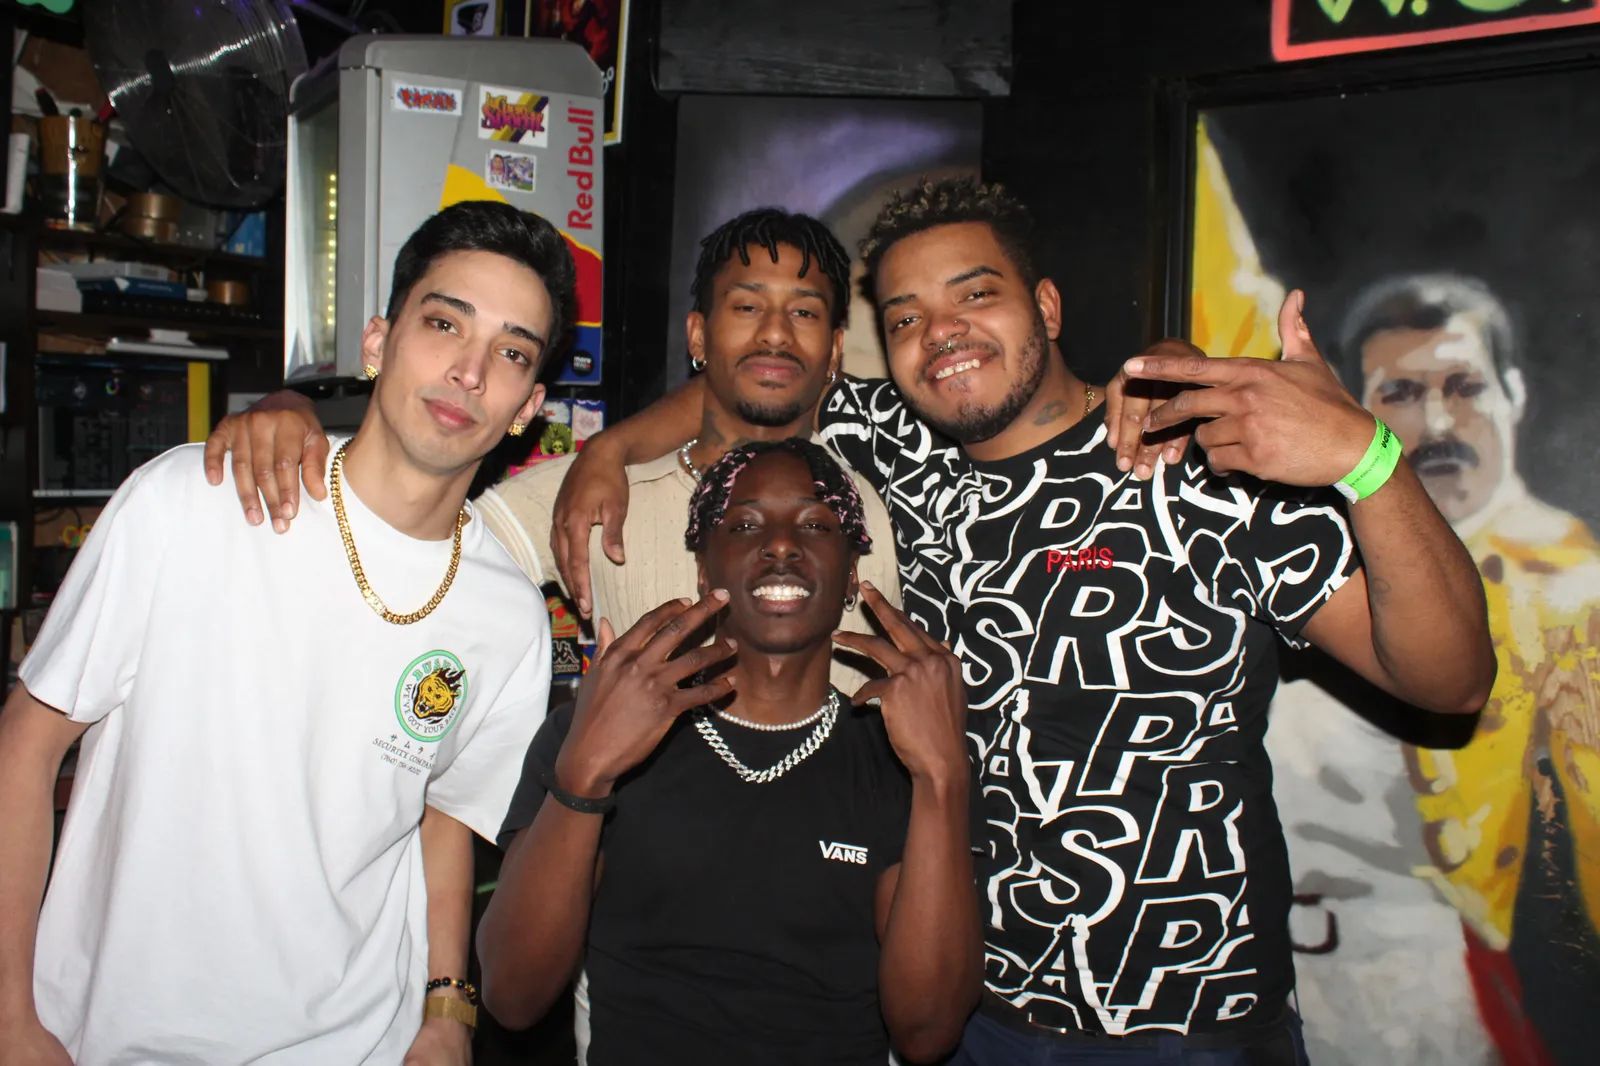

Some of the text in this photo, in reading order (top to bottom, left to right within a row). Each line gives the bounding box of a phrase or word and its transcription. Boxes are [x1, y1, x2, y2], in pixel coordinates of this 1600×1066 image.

[567, 107, 595, 230] Red Bull
[1046, 546, 1114, 574] PARIS
[408, 715, 422, 730] GOT
[424, 724, 444, 734] YOUR
[372, 737, 408, 760] SECURITY
[409, 754, 433, 770] COMPAN
[819, 840, 868, 865] VANS
